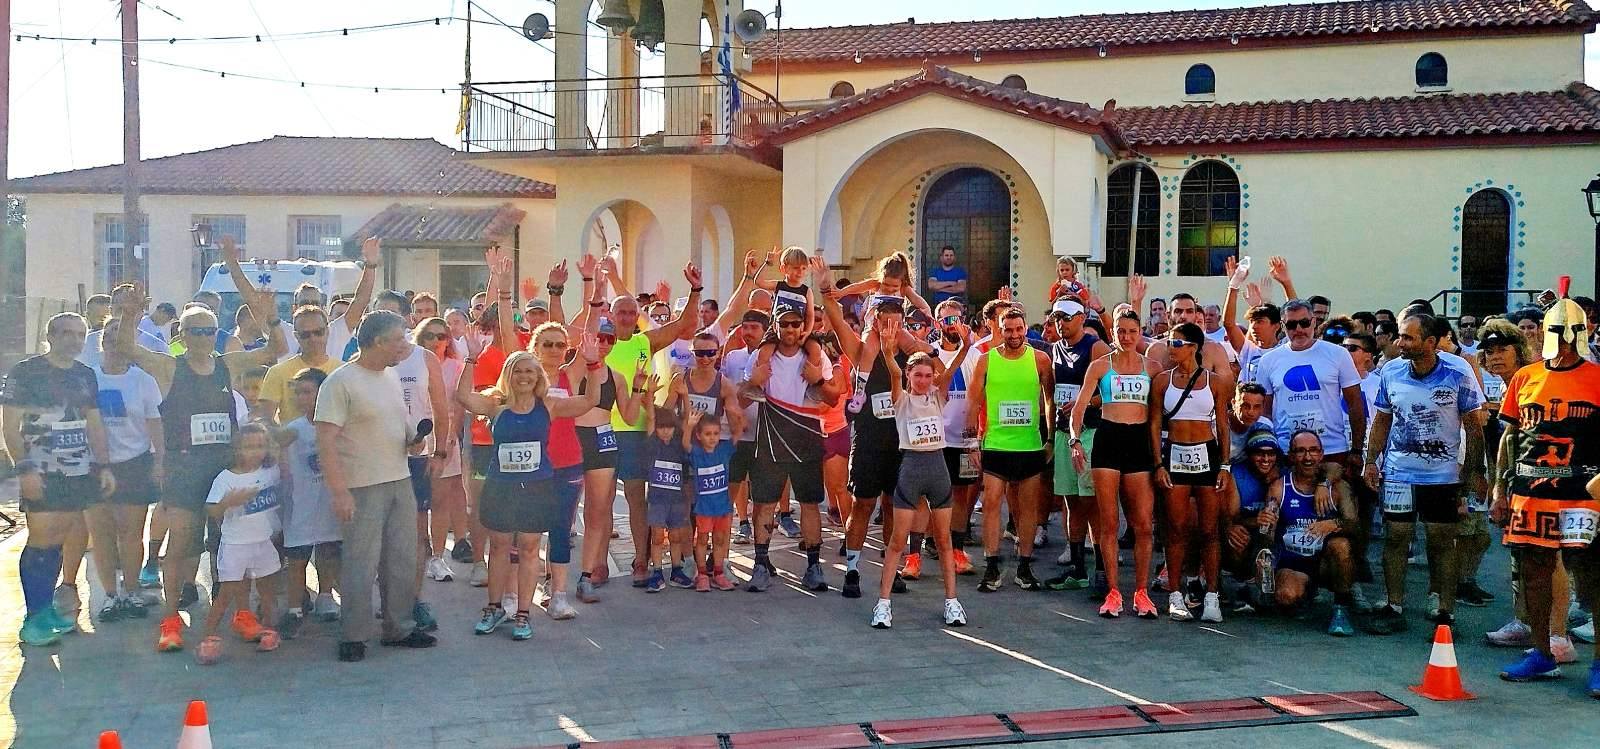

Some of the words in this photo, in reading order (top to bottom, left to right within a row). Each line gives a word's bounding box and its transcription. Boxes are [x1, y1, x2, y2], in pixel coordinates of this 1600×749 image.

[1119, 383, 1142, 393] 119
[1487, 386, 1499, 395] 17
[1287, 392, 1320, 402] affidea
[880, 398, 893, 409] 12
[201, 421, 225, 433] 106
[915, 423, 937, 437] 233
[1292, 418, 1315, 430] 257
[508, 450, 532, 463] 139
[1179, 453, 1201, 464] 123
[656, 472, 680, 484] 3369
[702, 475, 725, 489] 3377
[1566, 517, 1593, 531] 242
